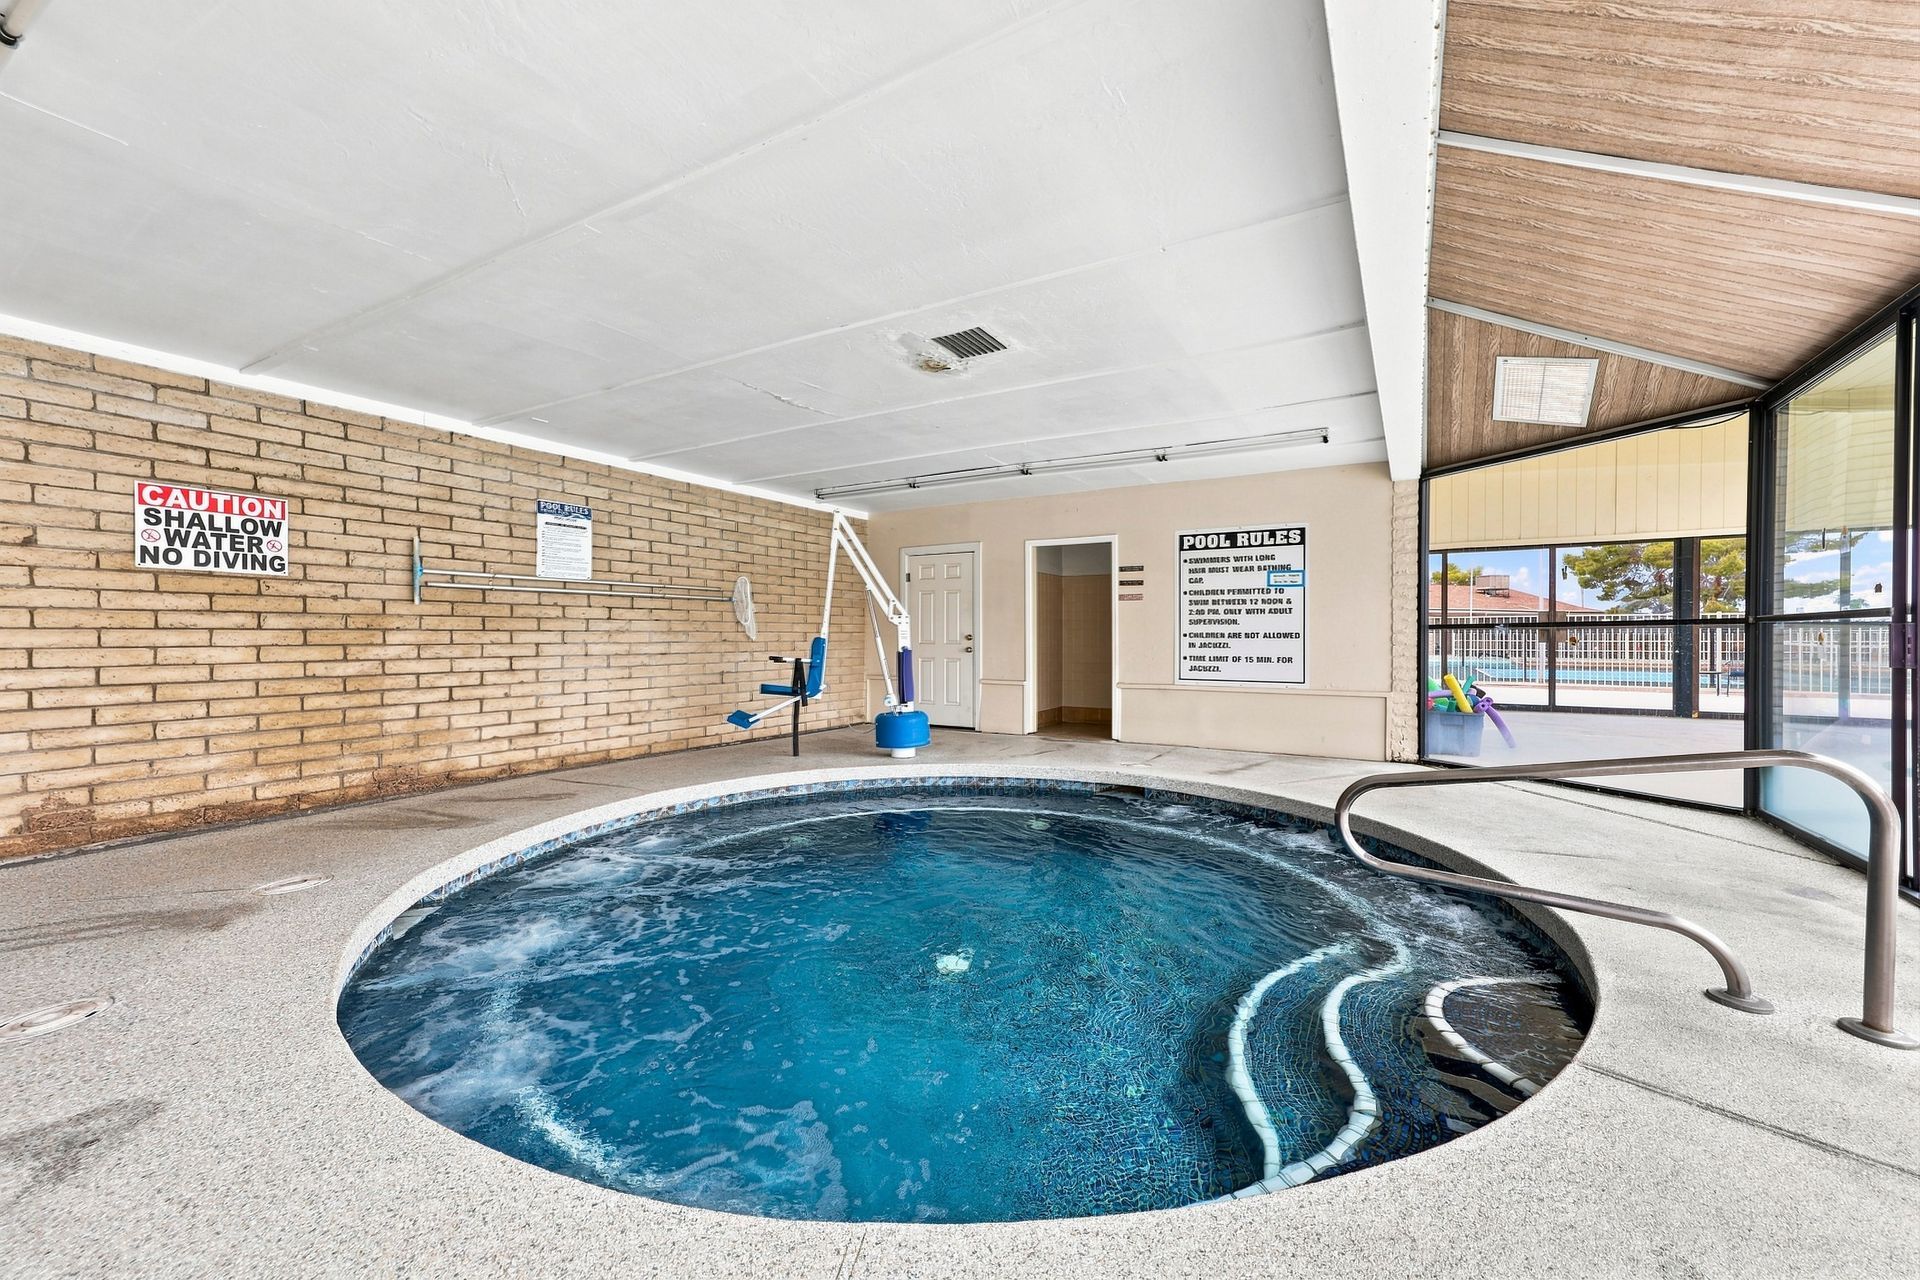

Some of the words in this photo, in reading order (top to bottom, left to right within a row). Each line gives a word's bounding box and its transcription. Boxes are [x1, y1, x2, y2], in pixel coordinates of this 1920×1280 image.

[141, 485, 282, 519] CAUTION
[540, 501, 561, 511] POOL
[564, 504, 589, 515] RULES
[143, 507, 282, 538] SHALLOW
[163, 527, 264, 554] WATER
[1183, 534, 1231, 550] POOL
[1236, 529, 1301, 547] RULES
[139, 544, 183, 566] NO
[193, 549, 286, 573] DIVING
[1188, 556, 1231, 565] SWIMMERS
[1233, 555, 1254, 563] WITH
[1255, 554, 1276, 562] LONG
[1188, 567, 1206, 575] HAIR
[1208, 566, 1229, 574] MUST
[1232, 565, 1255, 573] WEAR
[1257, 563, 1292, 572] BATHING
[1188, 588, 1225, 596] CHILDREN
[1227, 588, 1272, 596] PERMITTED
[1274, 587, 1285, 595] TO
[1188, 599, 1209, 607] SWIM
[1261, 598, 1283, 606] NOON
[1268, 607, 1293, 615] ADULT
[1188, 618, 1240, 626] SUPERVISION.
[1208, 655, 1229, 663] LIMIT
[1256, 656, 1274, 664] MIN.
[1276, 656, 1293, 664] FOR
[1188, 665, 1222, 673] JACUZZI.
